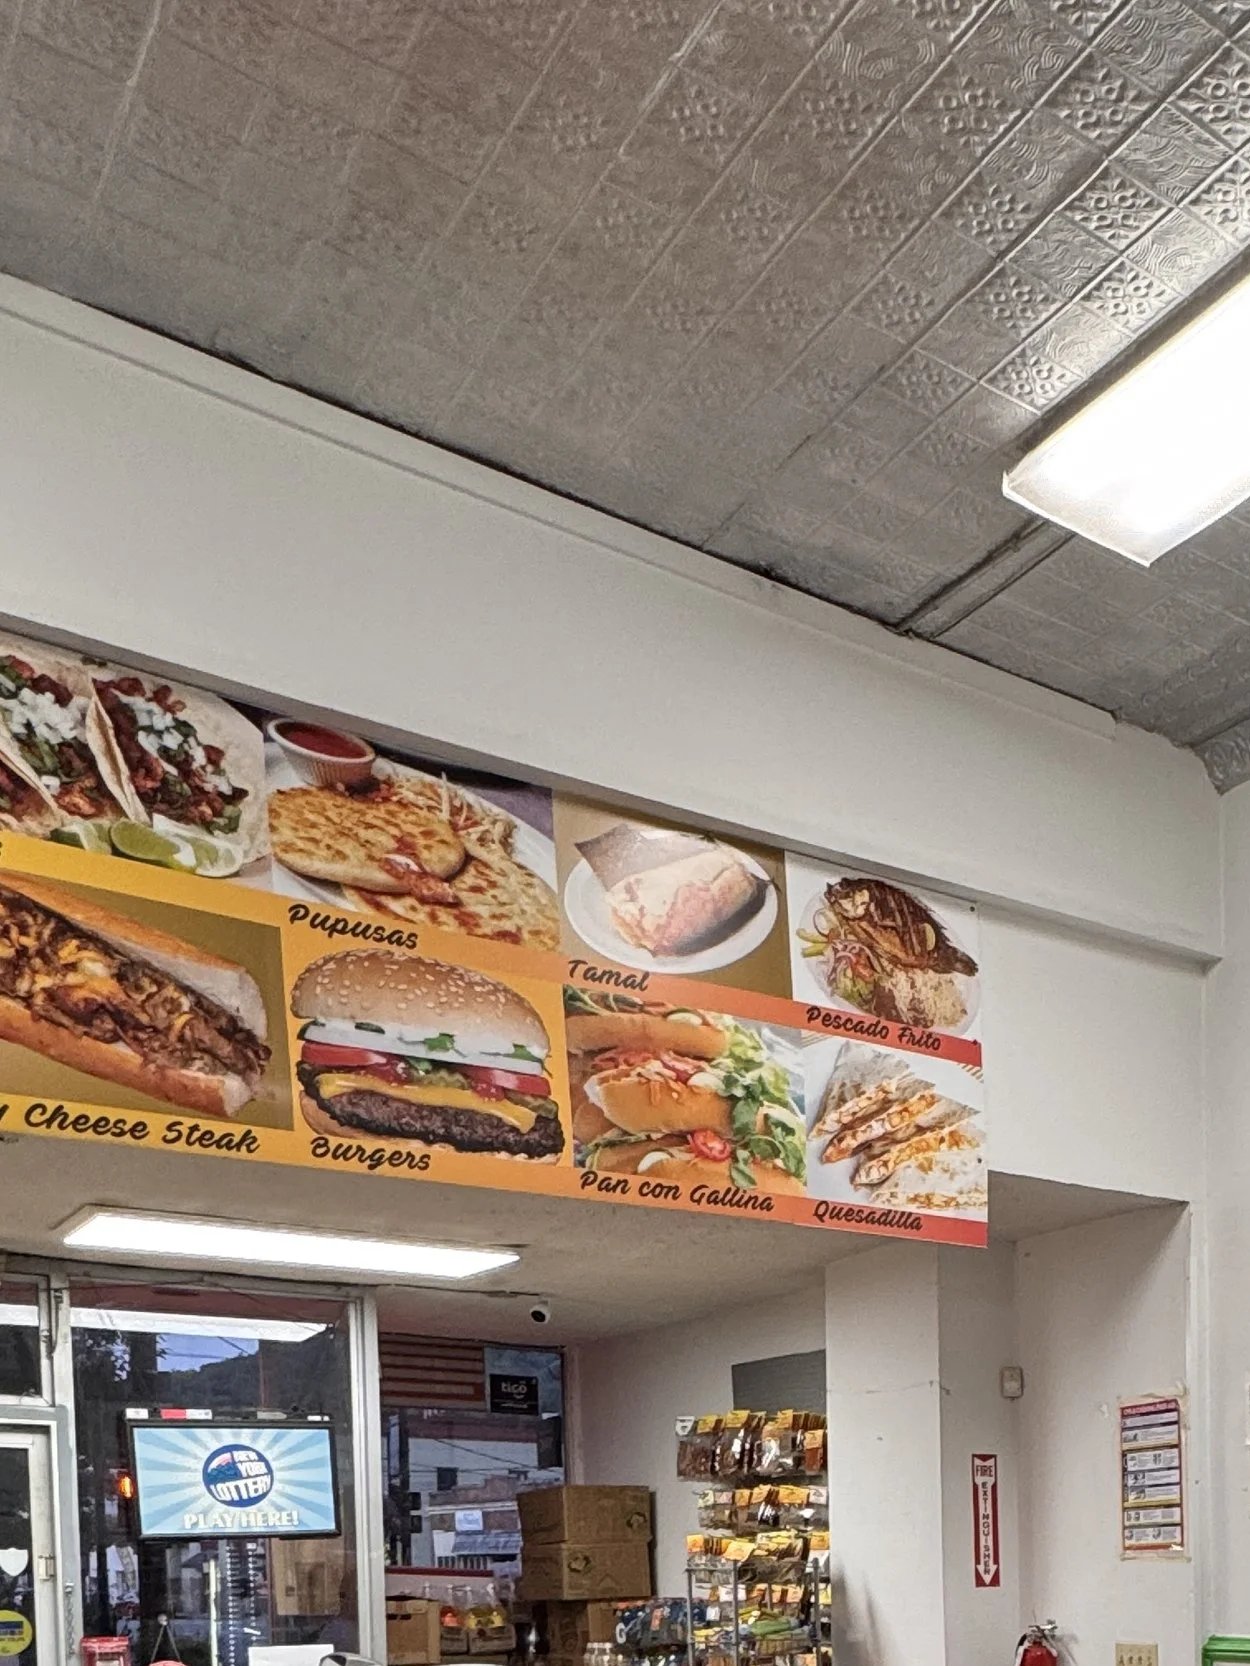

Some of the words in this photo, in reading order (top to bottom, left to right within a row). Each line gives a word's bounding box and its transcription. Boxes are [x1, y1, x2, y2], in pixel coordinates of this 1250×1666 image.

[288, 905, 418, 949] Pupusas
[568, 959, 650, 992] Tamal
[807, 1007, 889, 1040] Pescado
[897, 1027, 941, 1051] Frito
[23, 1103, 149, 1141] Cheese
[162, 1121, 261, 1155] Steak
[310, 1137, 431, 1172] Burgers
[580, 1171, 629, 1194] Pan
[639, 1180, 680, 1200] con
[690, 1184, 774, 1212] Gallina
[813, 1200, 922, 1232] Quesadilla
[210, 1475, 271, 1501] LOTTERY
[976, 1465, 993, 1477] FIRE
[184, 1512, 233, 1529] PLAY
[241, 1510, 298, 1528] HERE!
[982, 1481, 990, 1575] EXTINGUISHER
